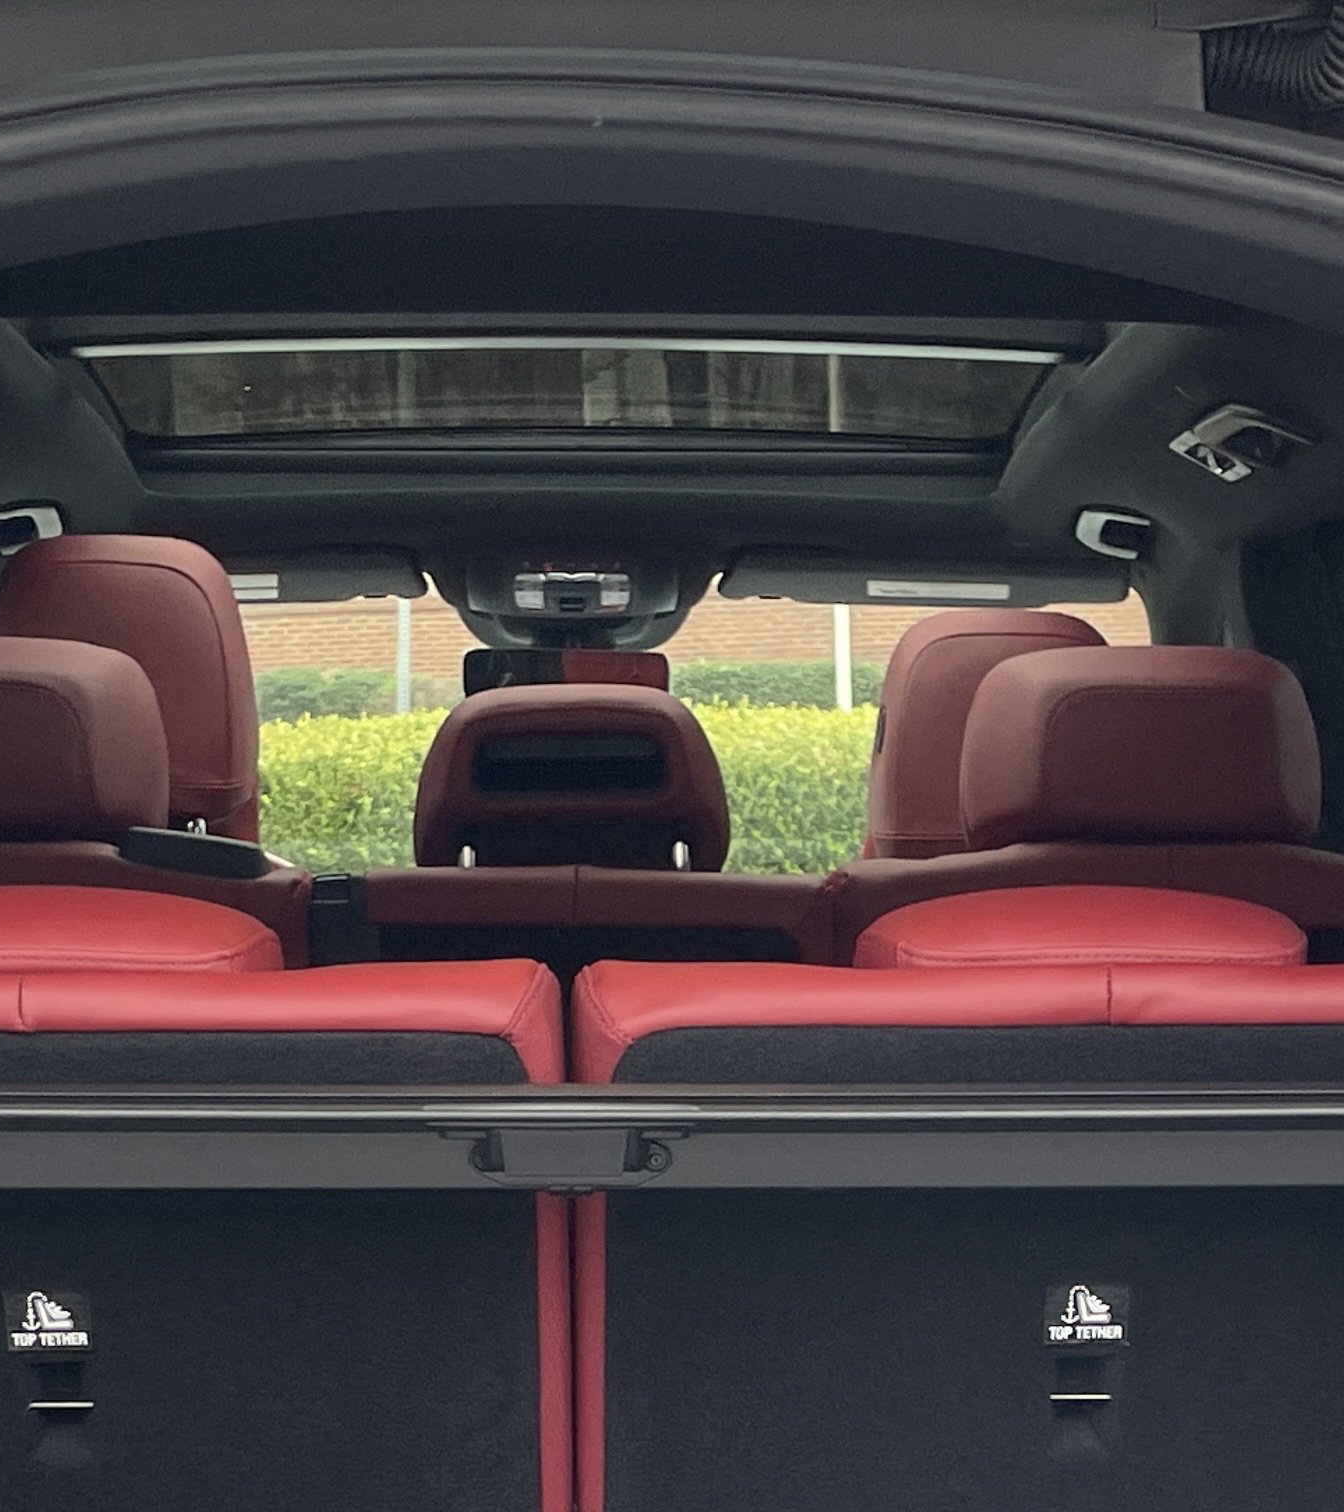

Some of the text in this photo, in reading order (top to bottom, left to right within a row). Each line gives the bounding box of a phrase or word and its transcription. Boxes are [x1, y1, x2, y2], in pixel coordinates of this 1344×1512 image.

[11, 1331, 89, 1346] TOP TETHER
[1048, 1325, 1123, 1341] TOP TETHER
